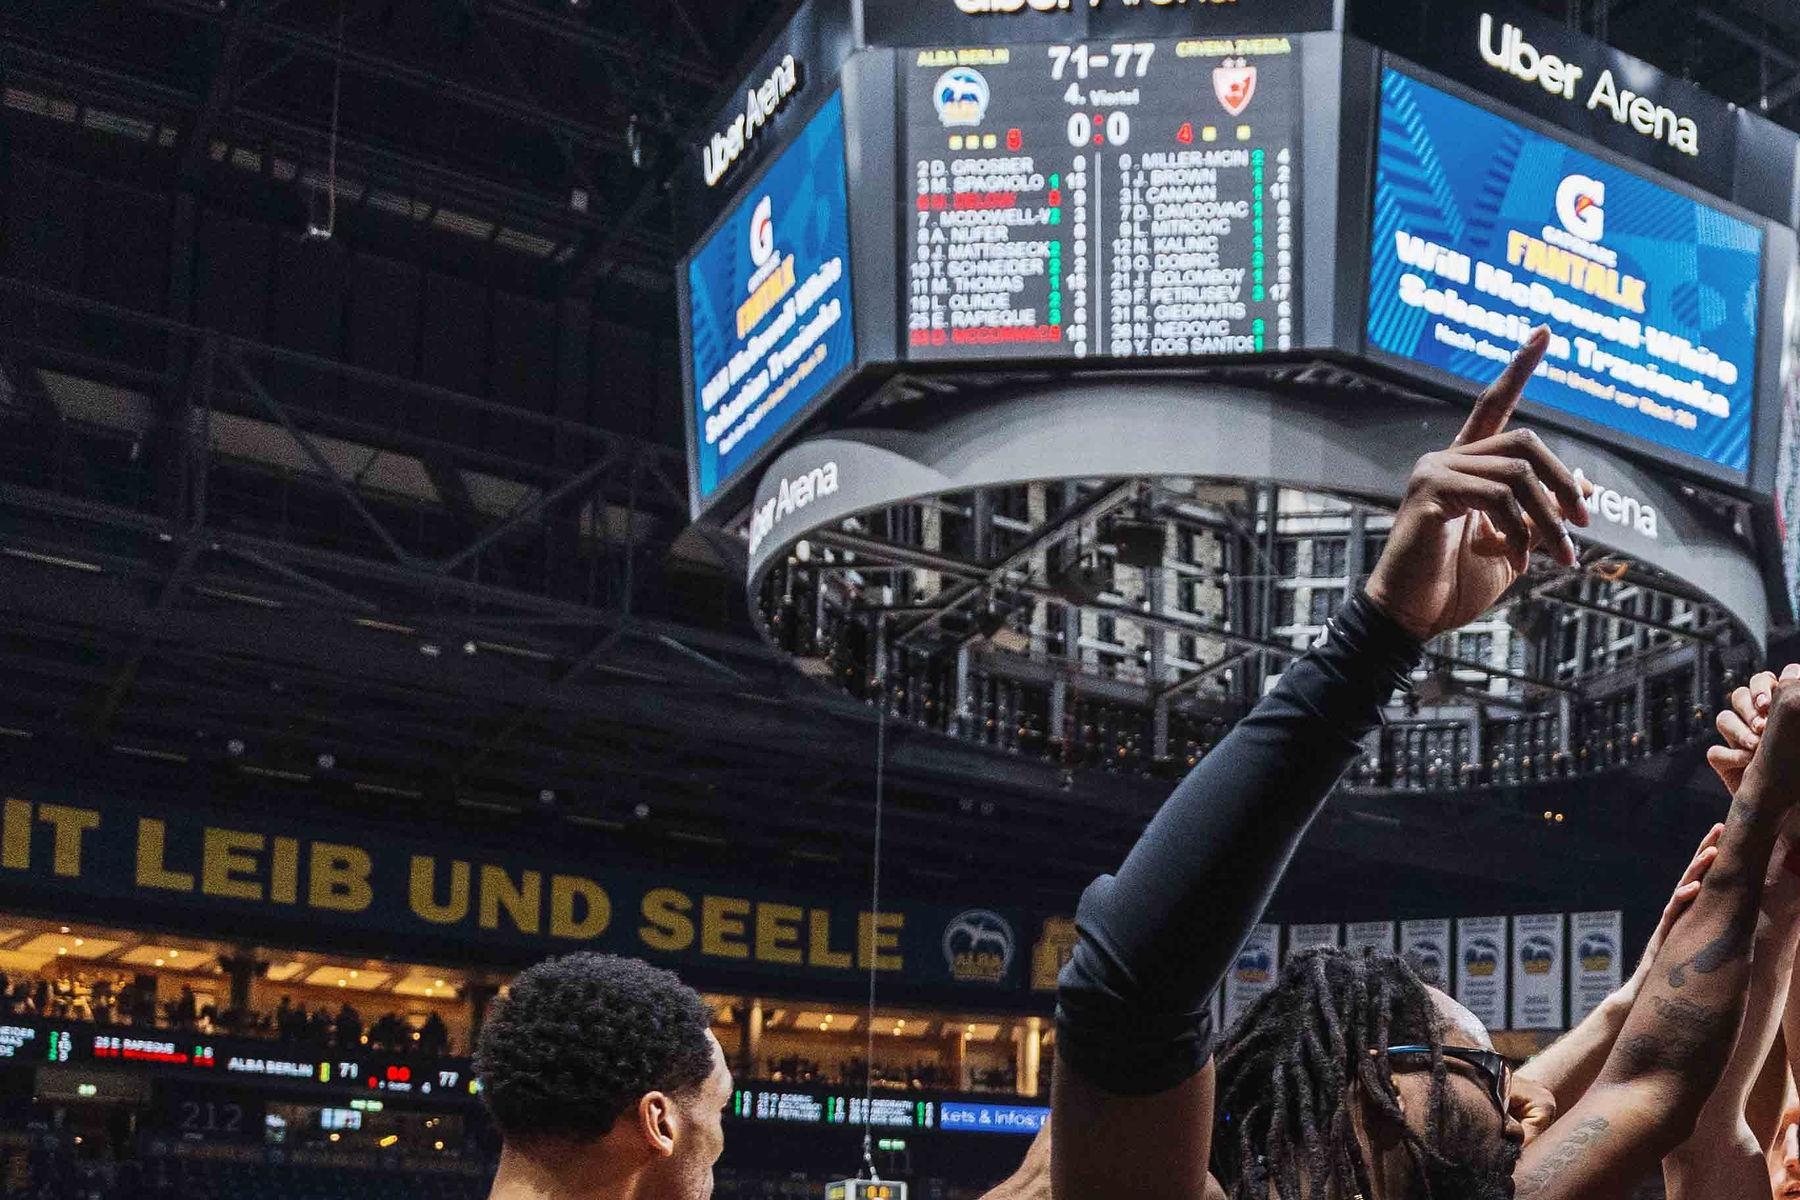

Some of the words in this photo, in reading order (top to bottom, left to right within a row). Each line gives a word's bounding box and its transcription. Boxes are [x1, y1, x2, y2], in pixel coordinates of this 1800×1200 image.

[702, 115, 745, 187] Uber
[745, 54, 797, 140] Arena
[1478, 12, 1583, 100] Uber
[1586, 69, 1699, 156] Arena
[775, 461, 839, 522] Arena
[2, 798, 101, 878] IT
[135, 816, 375, 912] LEIB
[409, 854, 612, 941] UND
[638, 887, 905, 972] SEELE
[228, 1056, 265, 1073] ALBA
